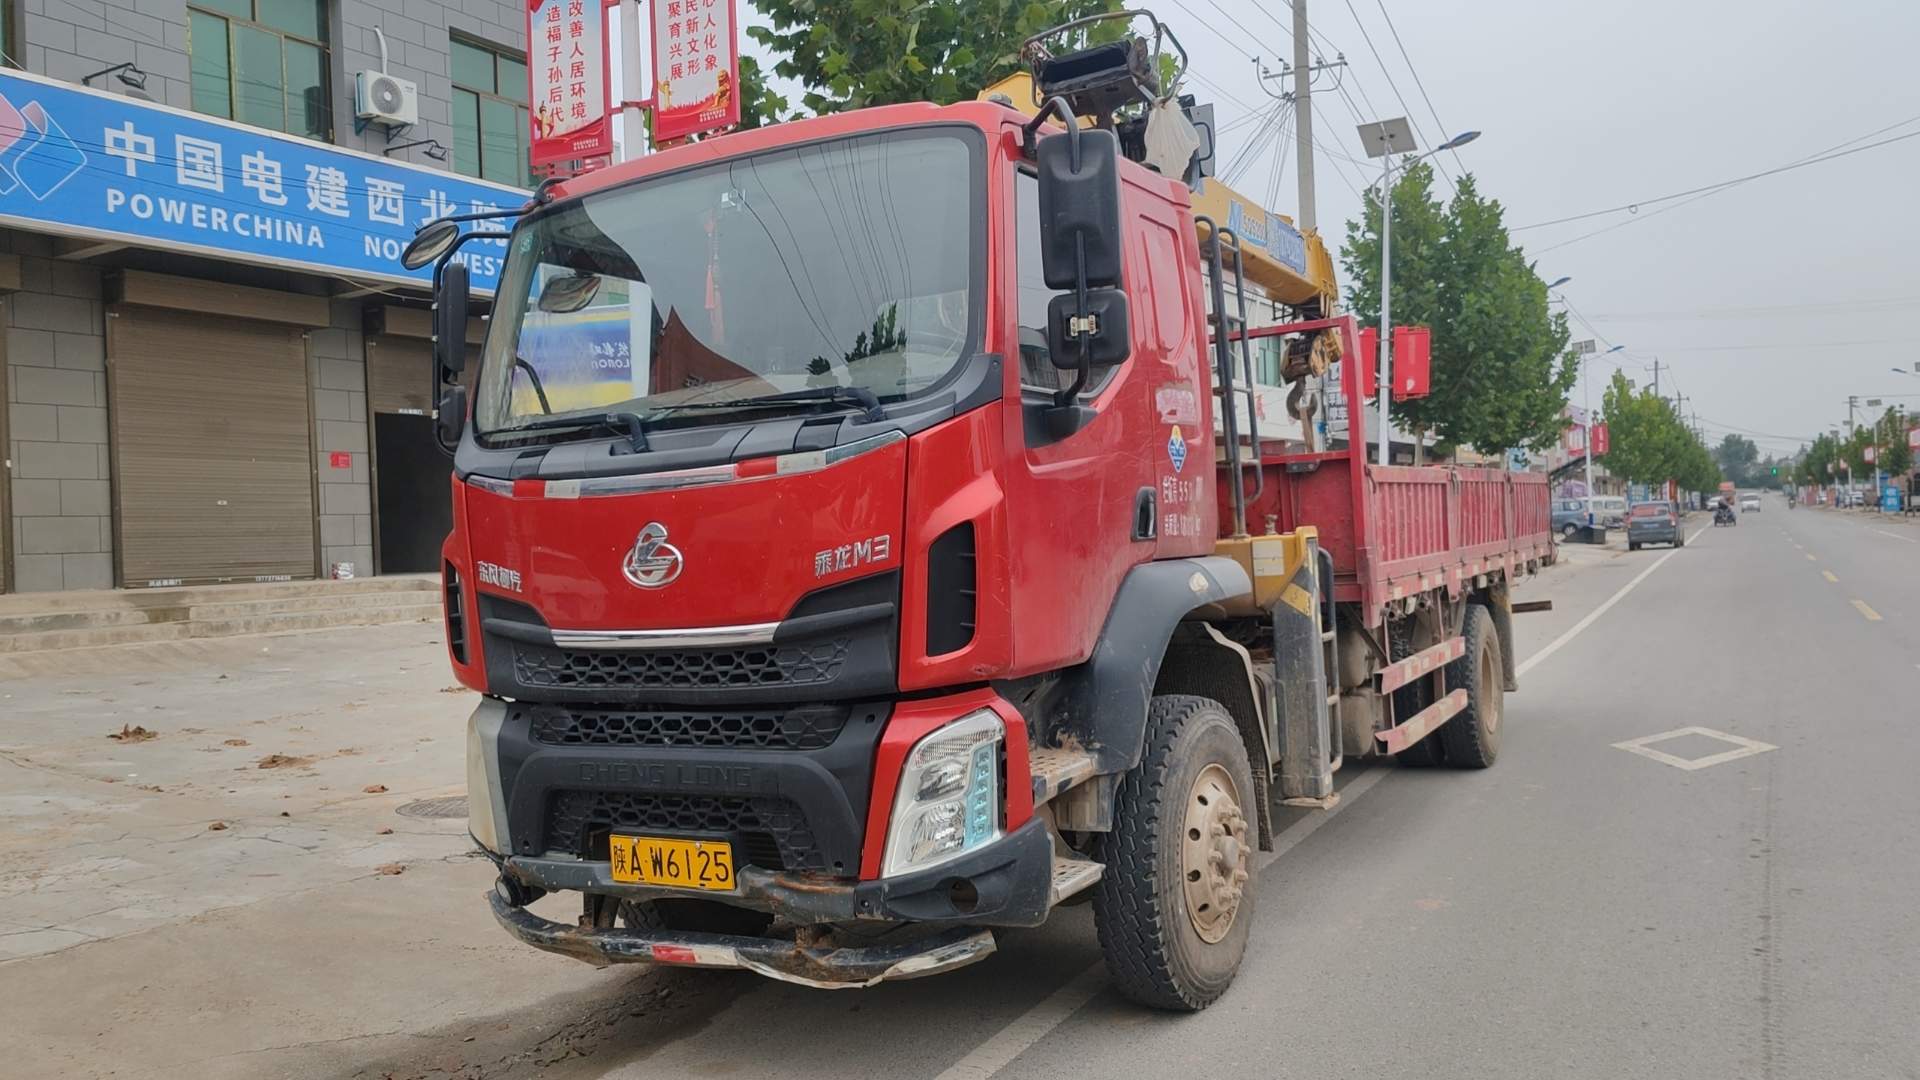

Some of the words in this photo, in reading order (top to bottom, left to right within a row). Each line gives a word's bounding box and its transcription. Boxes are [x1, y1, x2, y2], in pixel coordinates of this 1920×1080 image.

[546, 6, 564, 124] 造福子孙后代
[568, 0, 587, 119] 改善人居环境
[106, 188, 325, 249] POWERCHINA
[578, 760, 665, 784] CHENG
[676, 763, 752, 787] LONG
